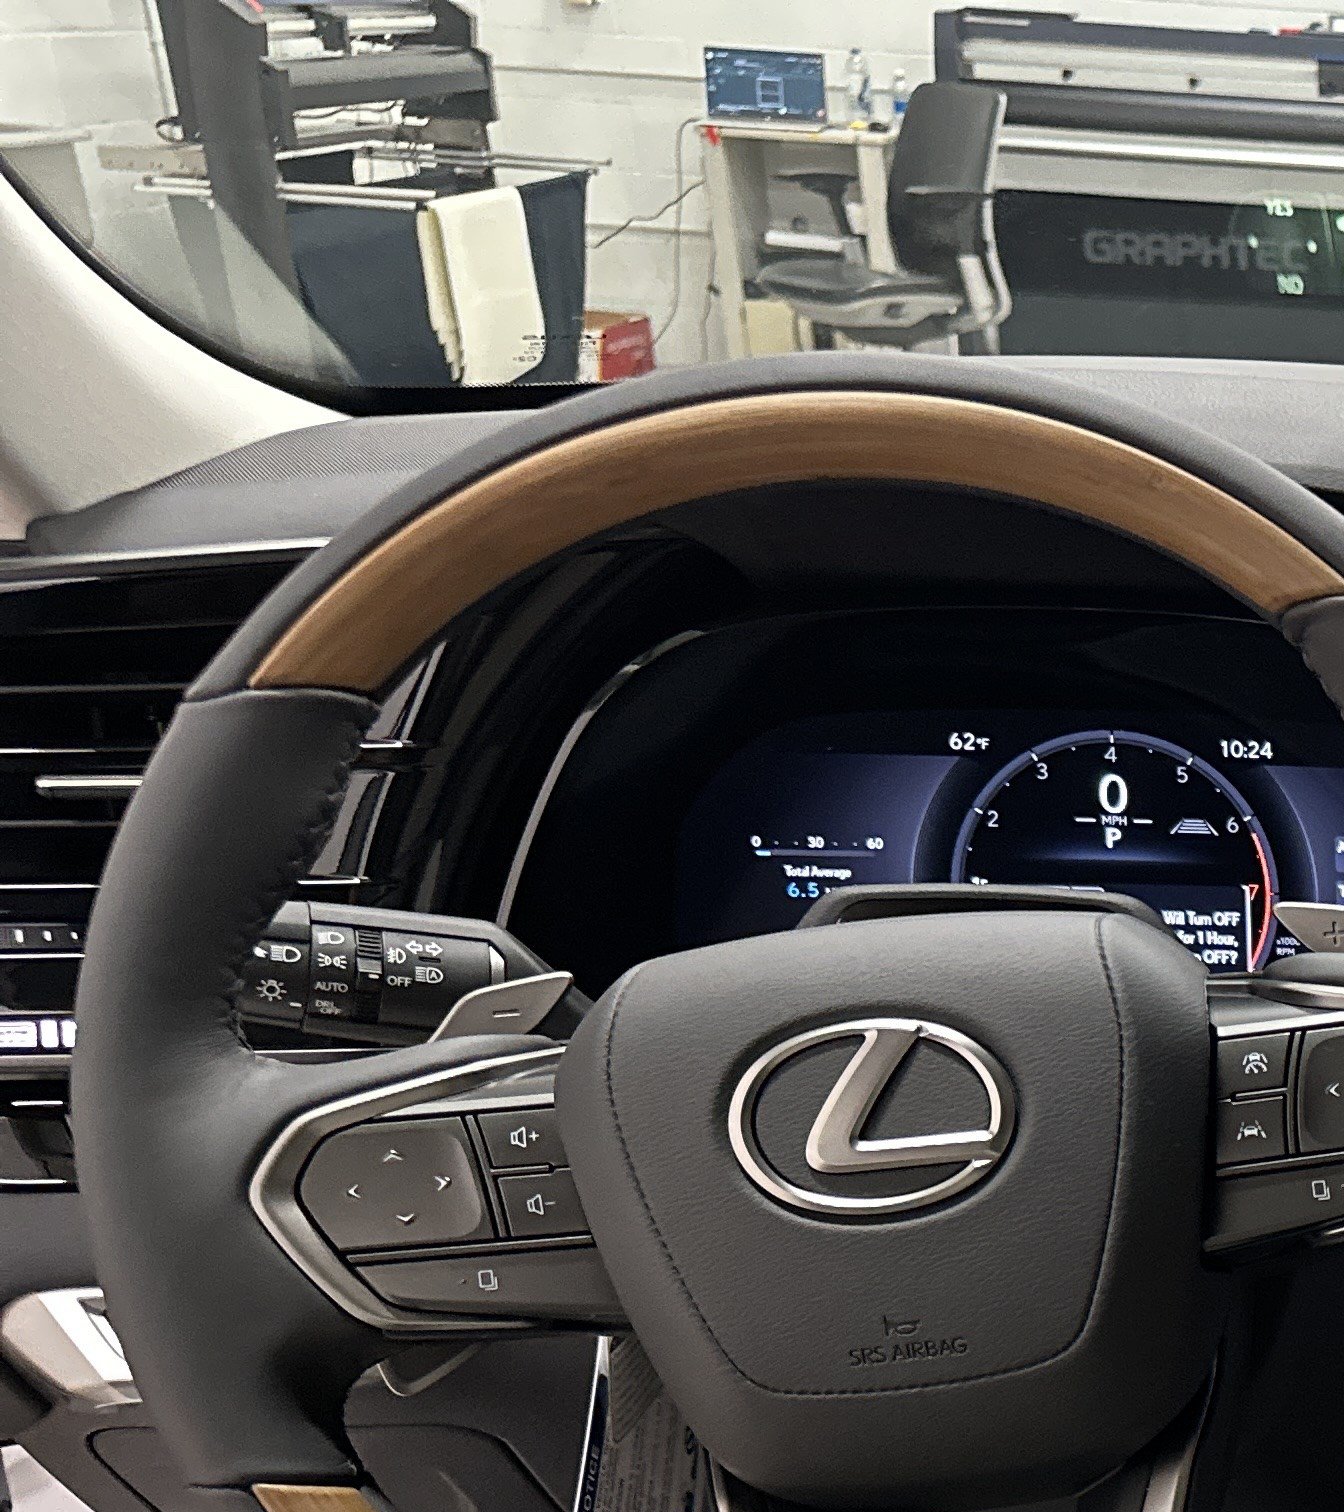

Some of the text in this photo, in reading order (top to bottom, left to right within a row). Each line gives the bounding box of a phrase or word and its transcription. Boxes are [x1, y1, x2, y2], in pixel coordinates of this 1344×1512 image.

[1084, 229, 1306, 272] GRAPHTEC
[1104, 747, 1118, 763] 4
[1220, 739, 1274, 760] 10:24
[1036, 763, 1049, 780] 3
[1176, 766, 1189, 784] 5
[1099, 773, 1129, 814] 0
[987, 810, 999, 828] 2
[1101, 814, 1128, 827] MPH
[1225, 819, 1238, 834] 6
[750, 835, 884, 850] 0 30 60
[1105, 827, 1122, 849] P
[783, 863, 852, 880] Total Average
[786, 882, 820, 899] 6.5
[1162, 909, 1241, 926] Will Turn OFF
[1197, 931, 1204, 945] 1
[1206, 931, 1238, 947] Hour,
[1204, 950, 1239, 965] OFF?
[1276, 947, 1296, 957] RPM
[314, 981, 349, 993] AUTO
[387, 975, 412, 988] OFF
[848, 1336, 969, 1368] SRS AIRBAG
